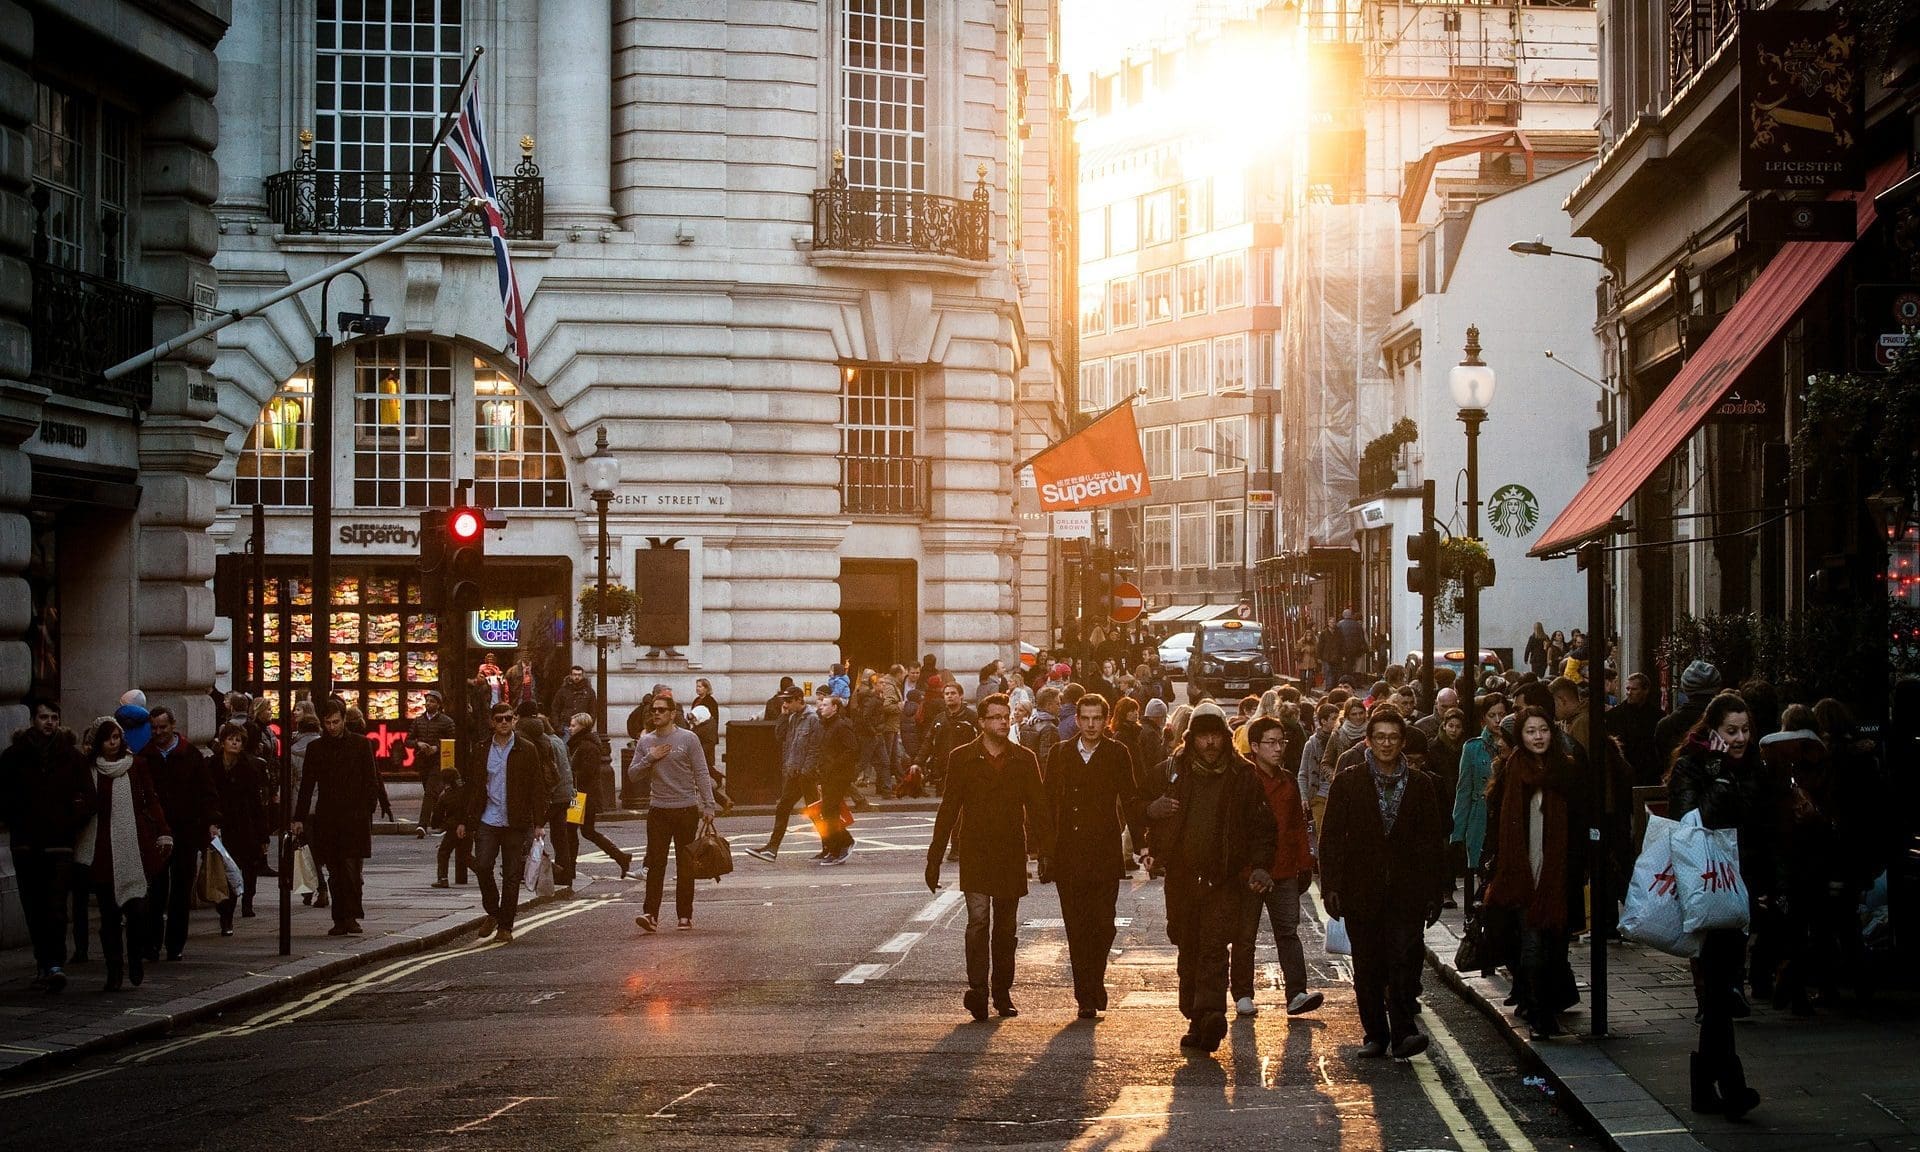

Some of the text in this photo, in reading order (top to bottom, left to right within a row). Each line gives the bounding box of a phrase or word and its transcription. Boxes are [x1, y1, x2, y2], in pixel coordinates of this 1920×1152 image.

[1765, 161, 1843, 172] LEICESTER
[1783, 175, 1825, 185] ARMS
[1042, 470, 1143, 504] Superdry
[658, 495, 701, 505] STREET
[339, 525, 421, 547] Superdry
[479, 609, 515, 621] T-SHIRT
[1701, 859, 1739, 895] H&M
